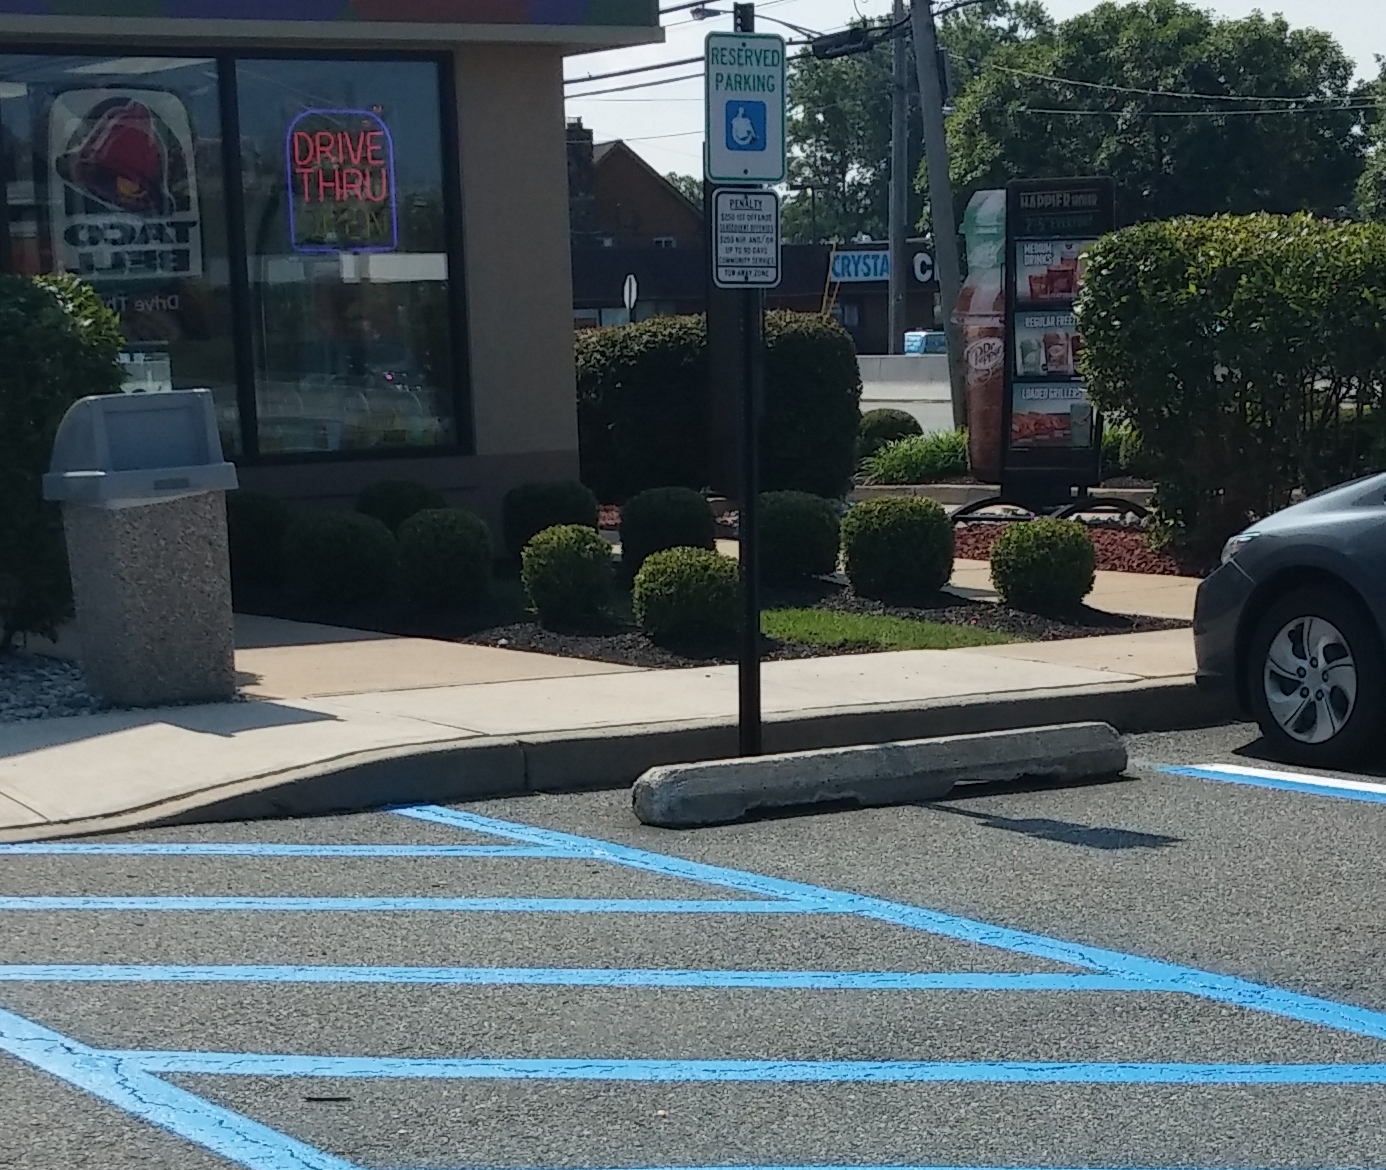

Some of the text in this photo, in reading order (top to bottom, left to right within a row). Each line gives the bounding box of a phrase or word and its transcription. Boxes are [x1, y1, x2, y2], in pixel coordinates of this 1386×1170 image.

[711, 47, 780, 67] RESERVED
[715, 72, 775, 92] PARKING
[293, 131, 385, 166] DRIVE
[295, 167, 387, 203] THRU
[729, 199, 762, 210] PENALTY
[1020, 192, 1071, 209] HAPPIER
[1024, 243, 1052, 254] MEDIUM
[832, 254, 890, 278] CRYSTA
[1024, 255, 1053, 266] DRINKS
[1025, 316, 1055, 327] REGULAR
[1021, 387, 1082, 400] LOADED GRILLERS
